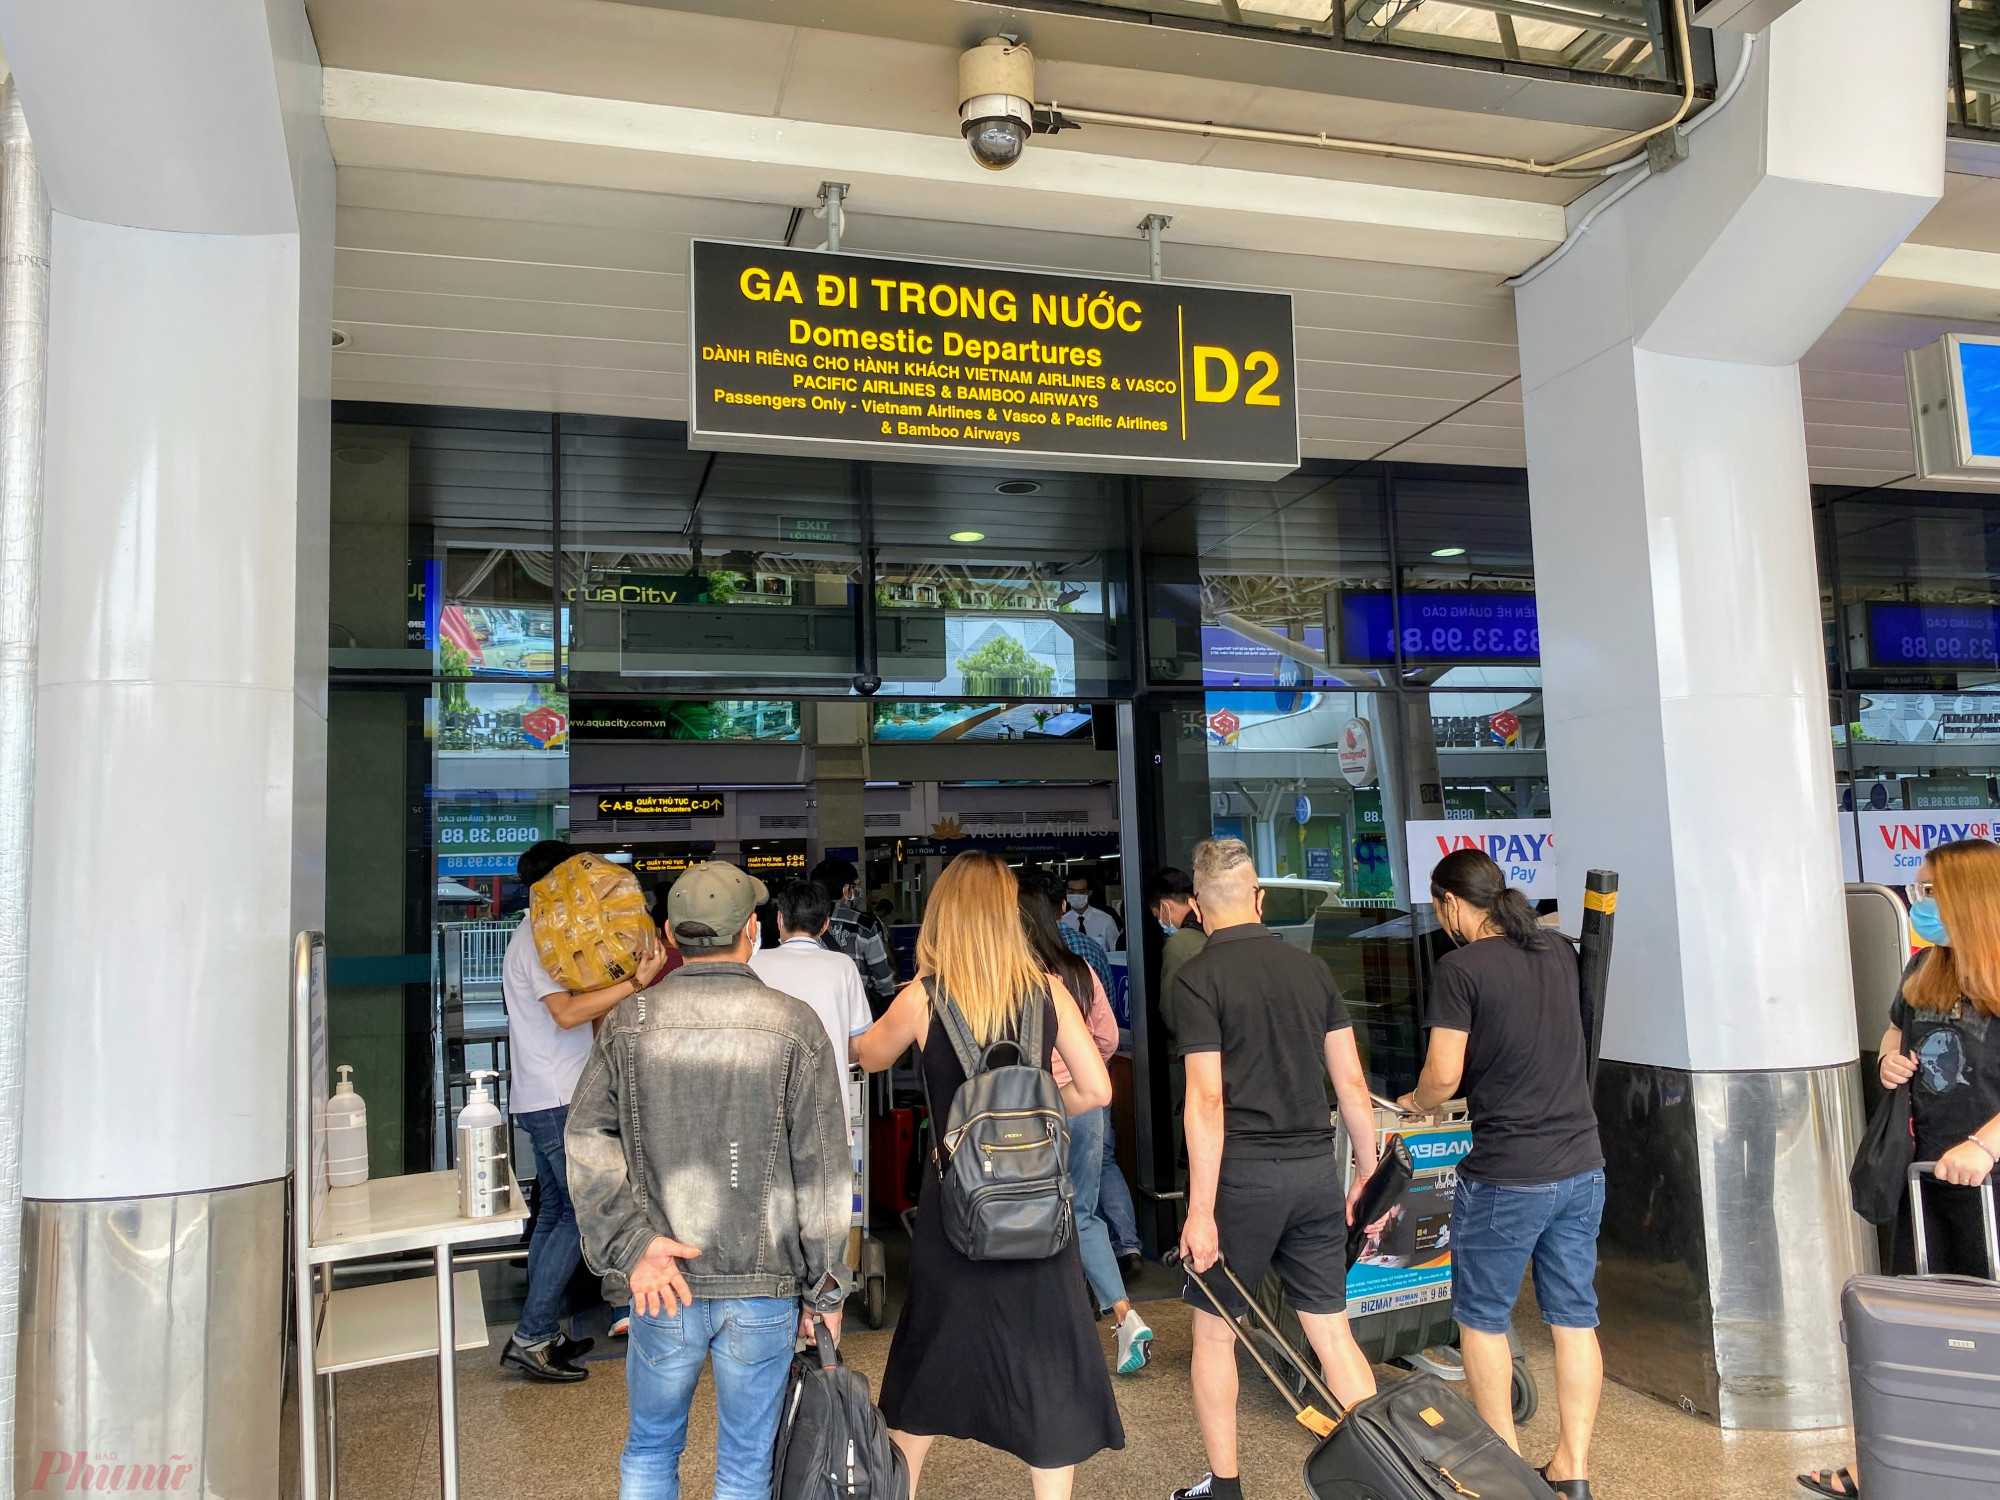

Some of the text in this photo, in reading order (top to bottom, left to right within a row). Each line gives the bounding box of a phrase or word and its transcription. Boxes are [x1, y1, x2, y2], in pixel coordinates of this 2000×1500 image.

[740, 267, 1142, 332] GA ĐI TRONG NƯỚC
[789, 319, 1102, 368] Domestic Departures
[702, 344, 1177, 394] DÀNH RIÊNG CHO HÀNH KHÁCH VIETNAM AIRLINES & VASCO
[1193, 345, 1281, 406] D2
[793, 375, 1099, 408] PACIFIC AIRLINES & BAMBOO AIRWAYS
[714, 389, 806, 410] Passengers
[811, 396, 847, 414] Only
[862, 400, 922, 417] Vietnam
[927, 404, 982, 420] Airlines
[987, 408, 998, 421] &
[1003, 409, 1047, 424] Vasco
[1051, 412, 1061, 425] &
[1066, 413, 1112, 428] Pacific
[1116, 416, 1168, 431] Airlines
[881, 421, 1021, 444] & Bamboo Airways
[797, 520, 830, 531] EXIT
[569, 719, 666, 729] ww.aquacity.com.vn
[613, 801, 633, 810] A-B
[691, 800, 710, 809] C-D
[967, 820, 1109, 839] Vietnam Airlines
[1894, 853, 1921, 867] Scan
[1510, 866, 1537, 883] Pay
[1409, 1140, 1473, 1158] ABBAN
